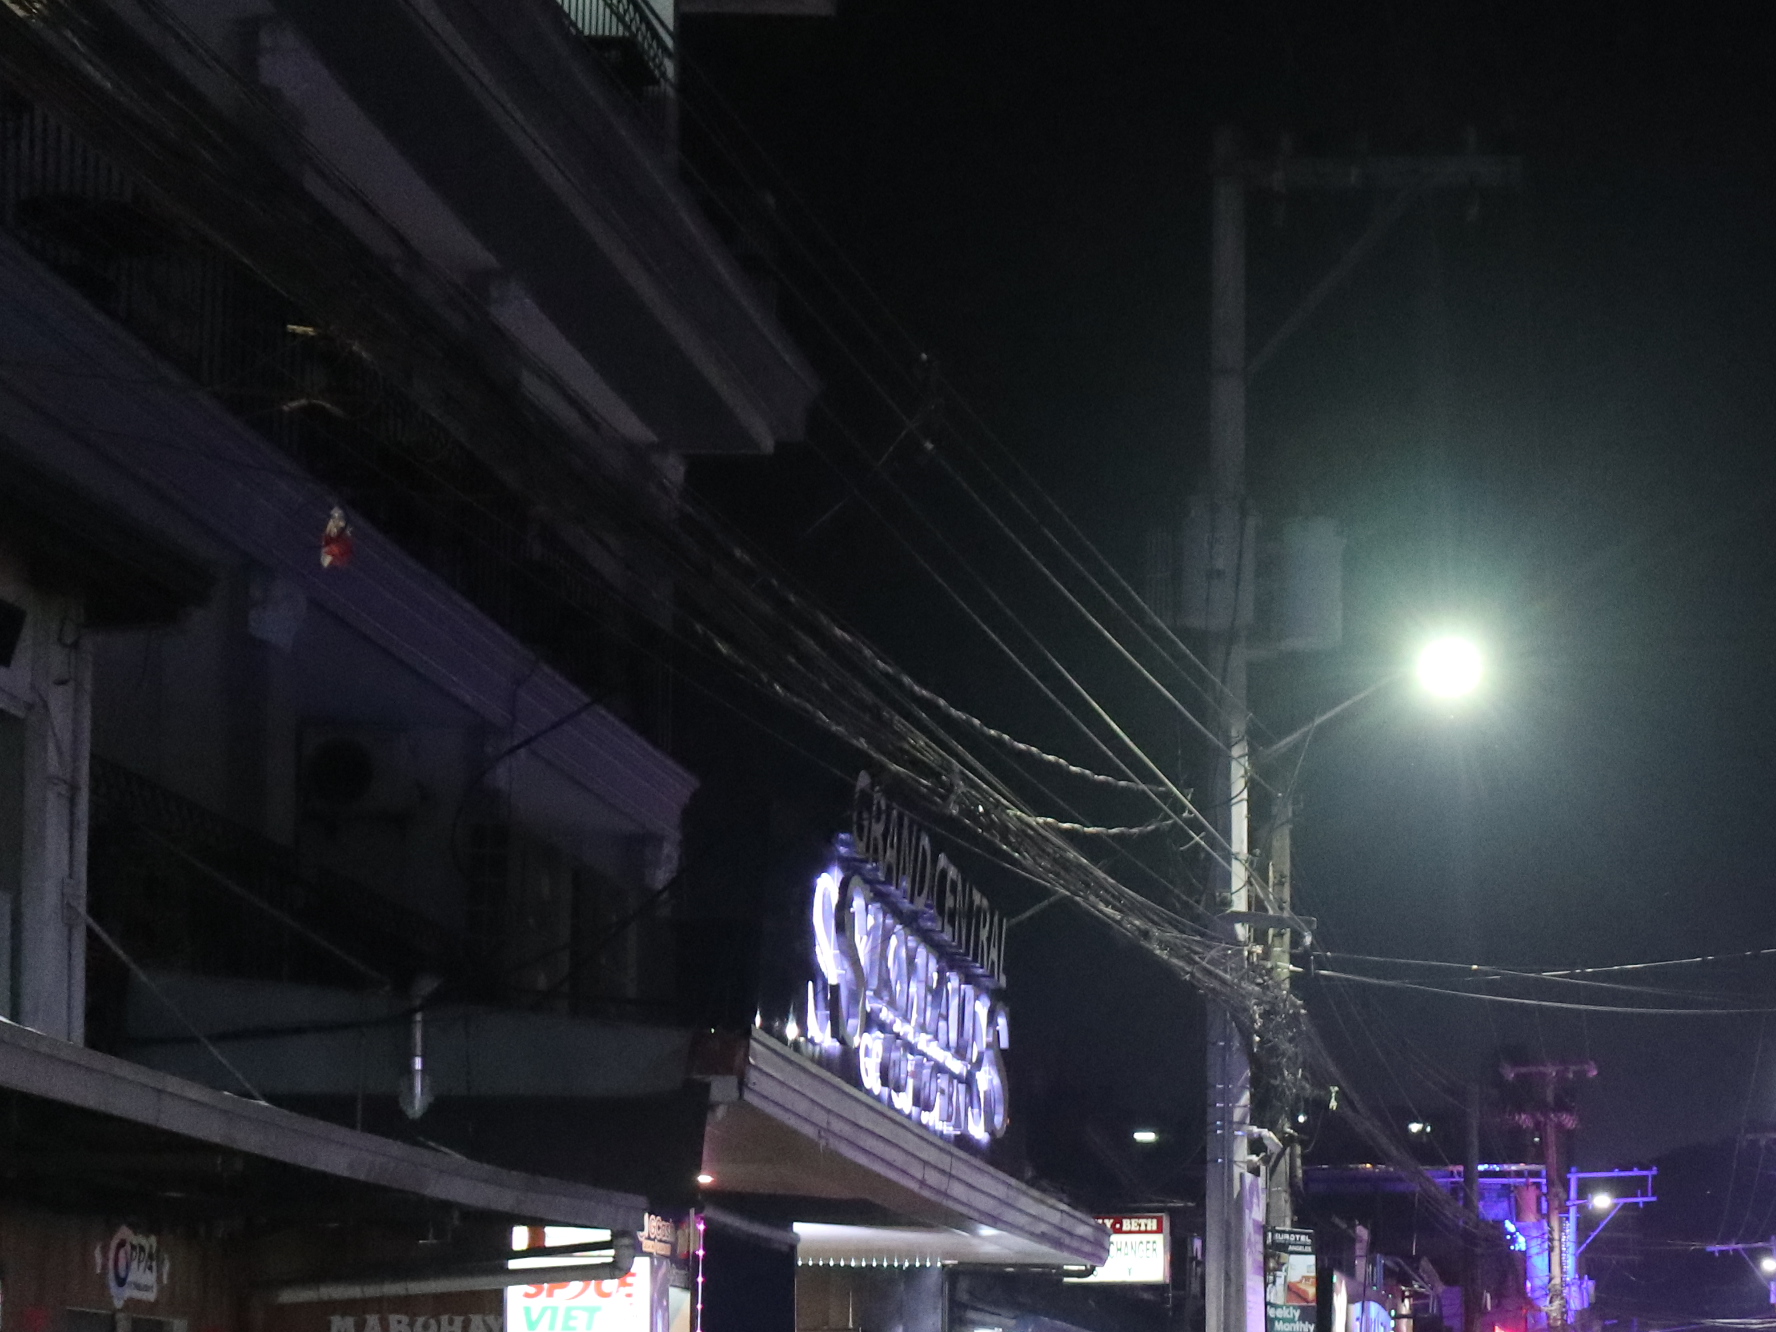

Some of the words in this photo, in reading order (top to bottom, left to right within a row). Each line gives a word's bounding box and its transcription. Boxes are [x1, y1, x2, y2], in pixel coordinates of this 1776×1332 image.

[1122, 1218, 1158, 1231] BETH
[523, 1306, 602, 1331] VIET
[1267, 1306, 1300, 1321] eekly
